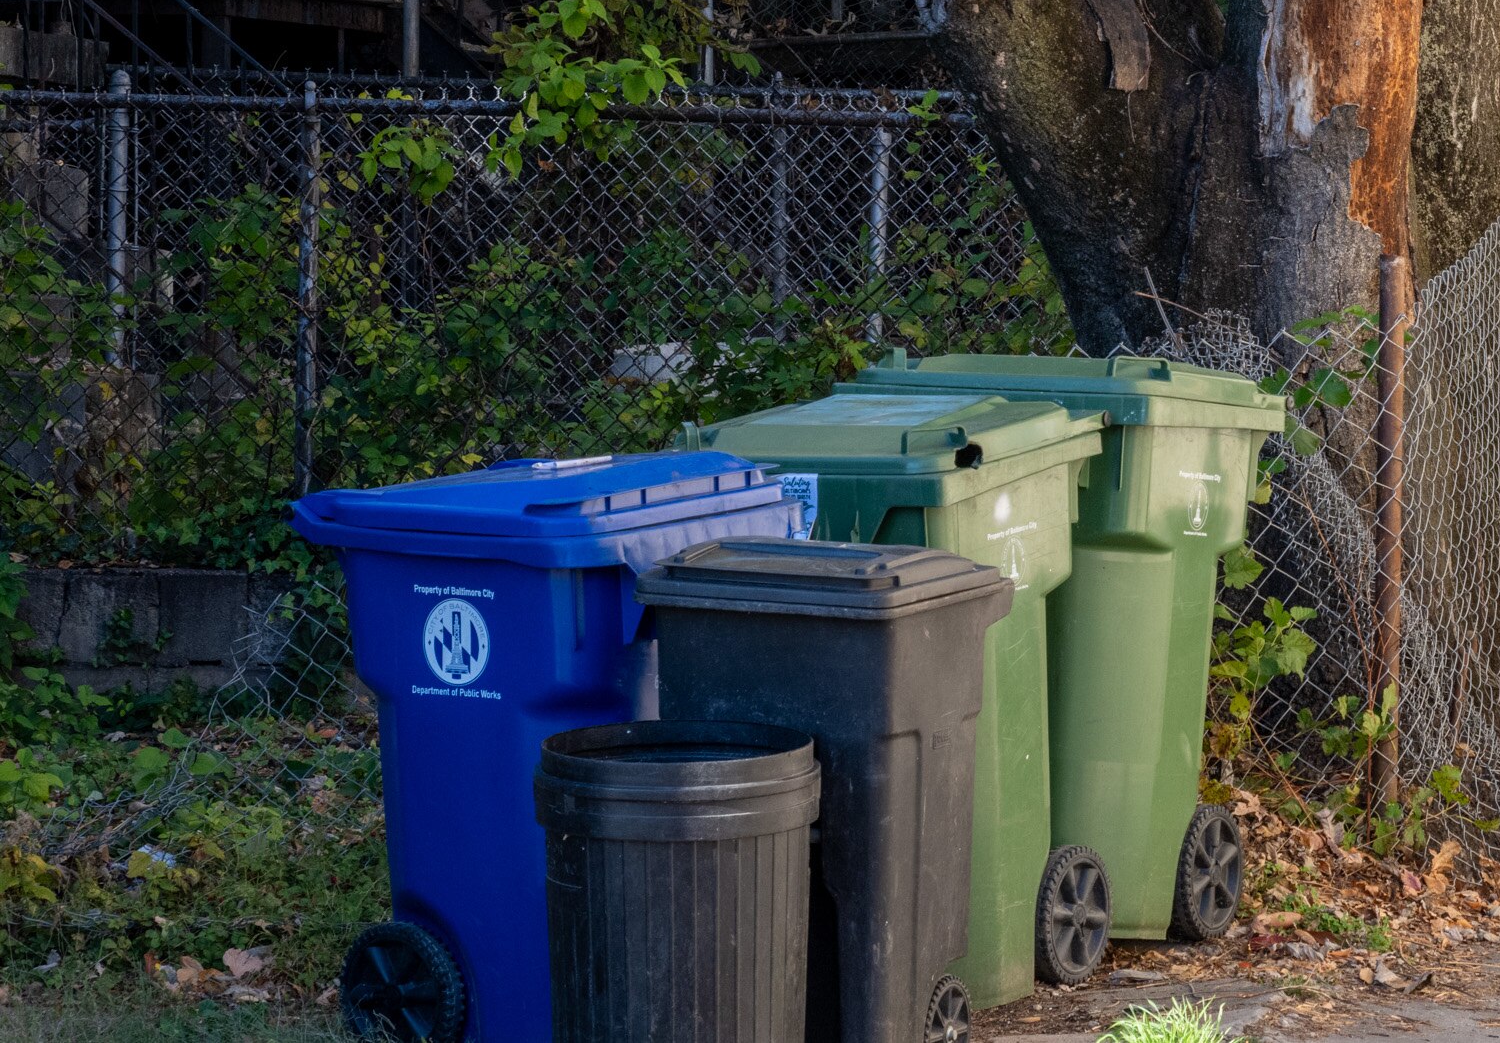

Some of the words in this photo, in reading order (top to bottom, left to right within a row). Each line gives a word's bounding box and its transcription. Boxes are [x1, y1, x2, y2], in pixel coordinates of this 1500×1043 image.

[784, 476, 811, 490] Saluting
[413, 584, 442, 597] Property
[443, 586, 450, 595] of
[450, 586, 482, 597] Baltimore
[482, 589, 495, 600] City
[427, 615, 439, 635] CITY
[438, 604, 448, 615] OF
[449, 602, 486, 639] BALTIMORE
[411, 684, 450, 696] Department
[451, 687, 458, 696] of
[459, 688, 480, 698] Public
[480, 689, 502, 700] Works
